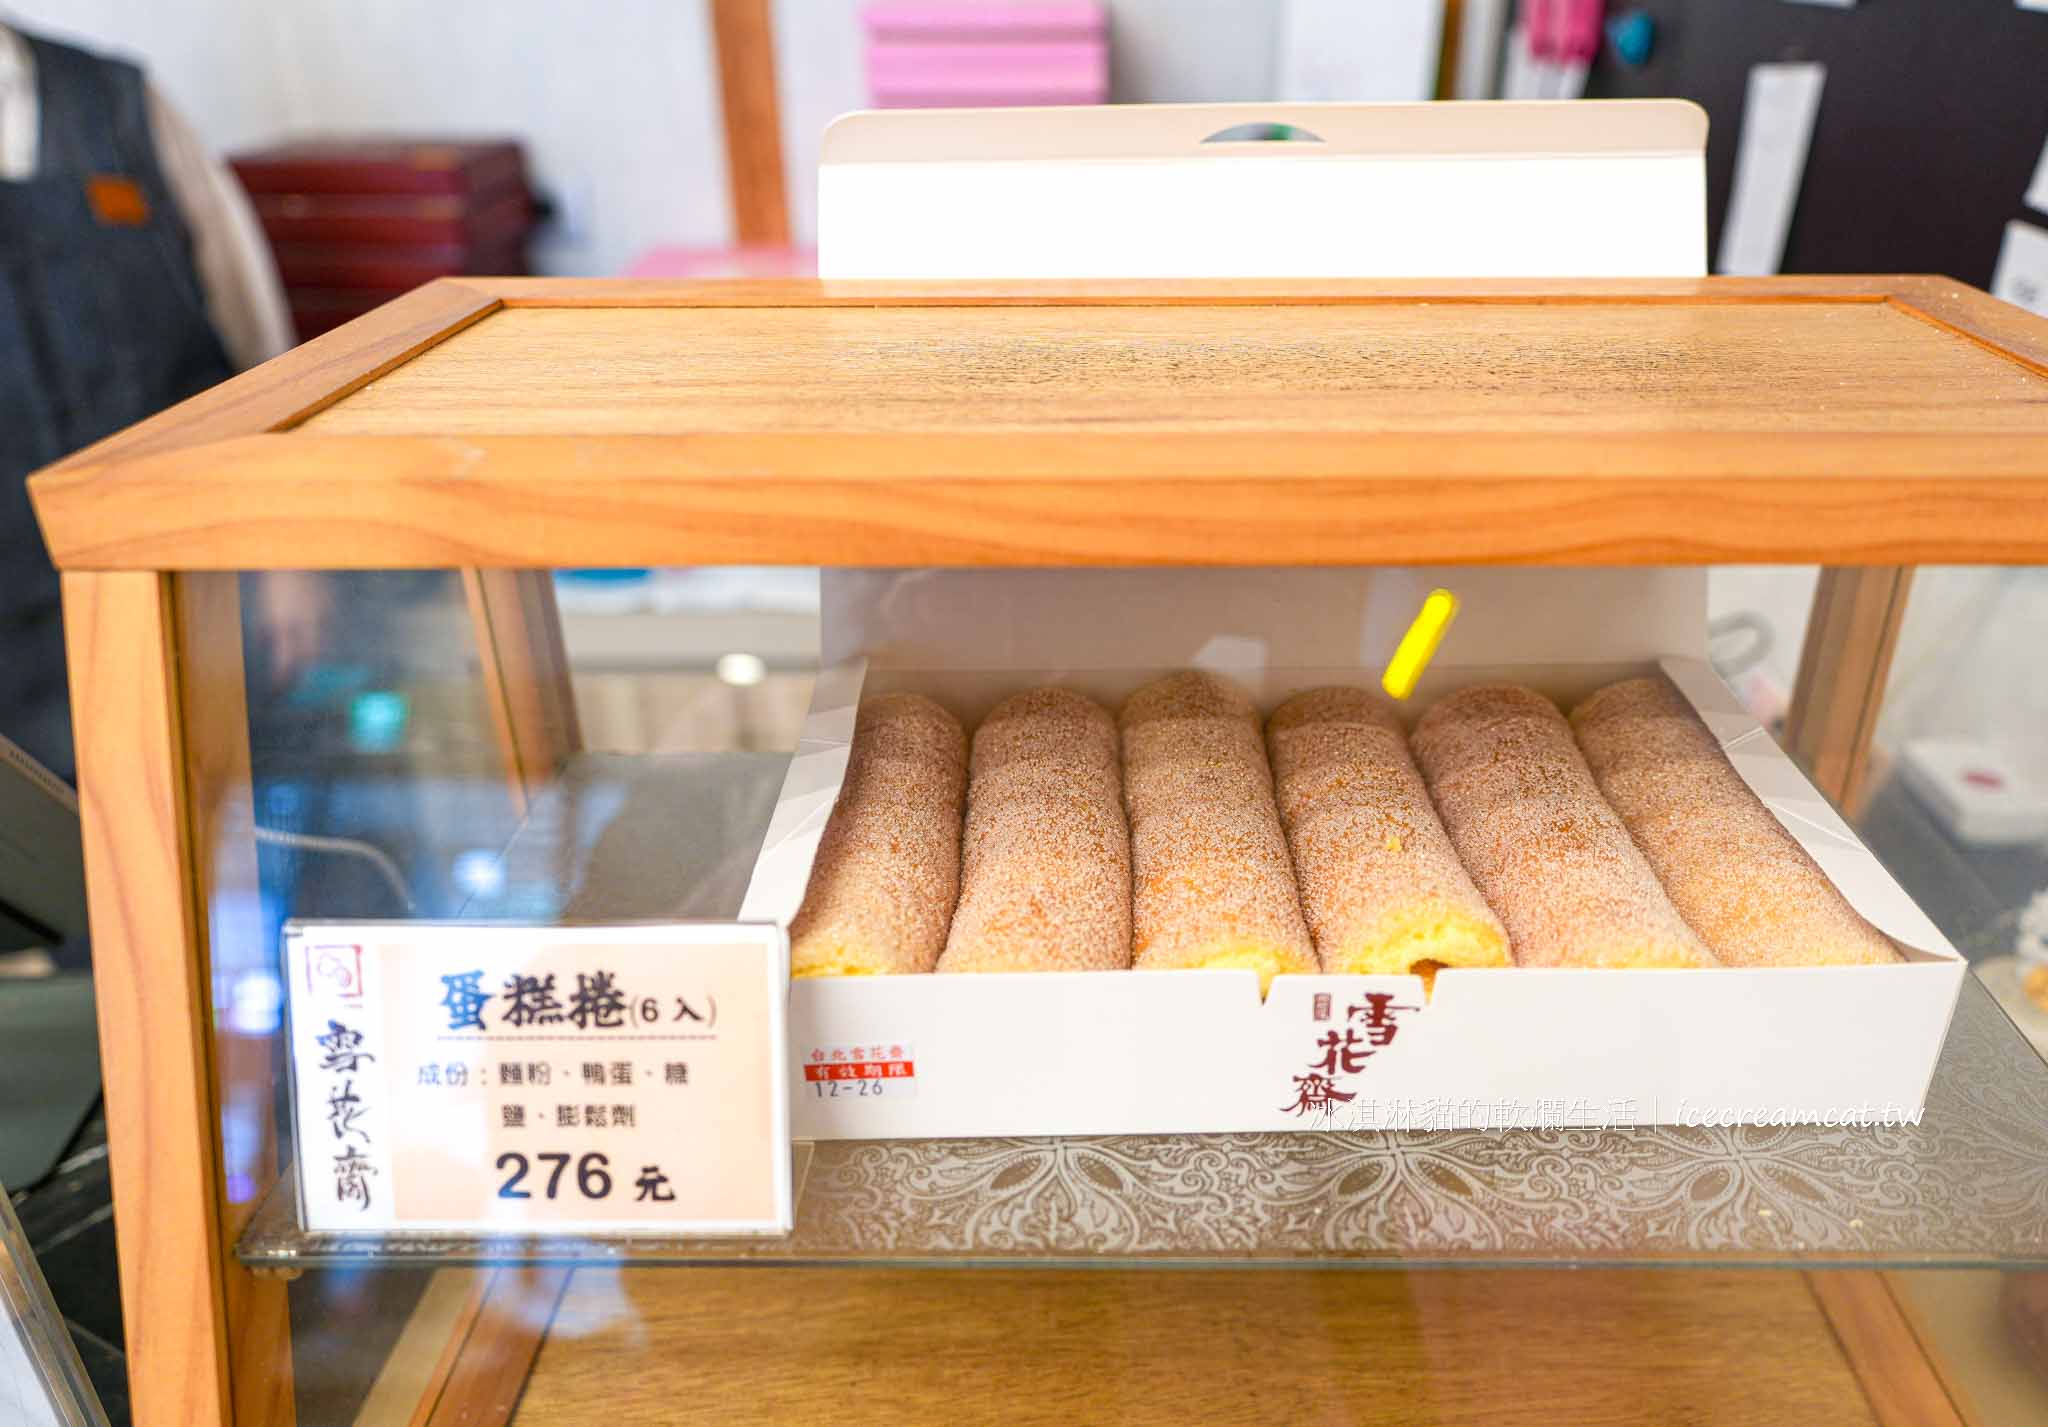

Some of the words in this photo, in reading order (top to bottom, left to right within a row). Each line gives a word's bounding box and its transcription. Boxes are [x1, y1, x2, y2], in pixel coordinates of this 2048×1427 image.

[815, 1079, 884, 1098] 12-26
[496, 1152, 613, 1200] 276
[635, 1164, 676, 1201] 元
